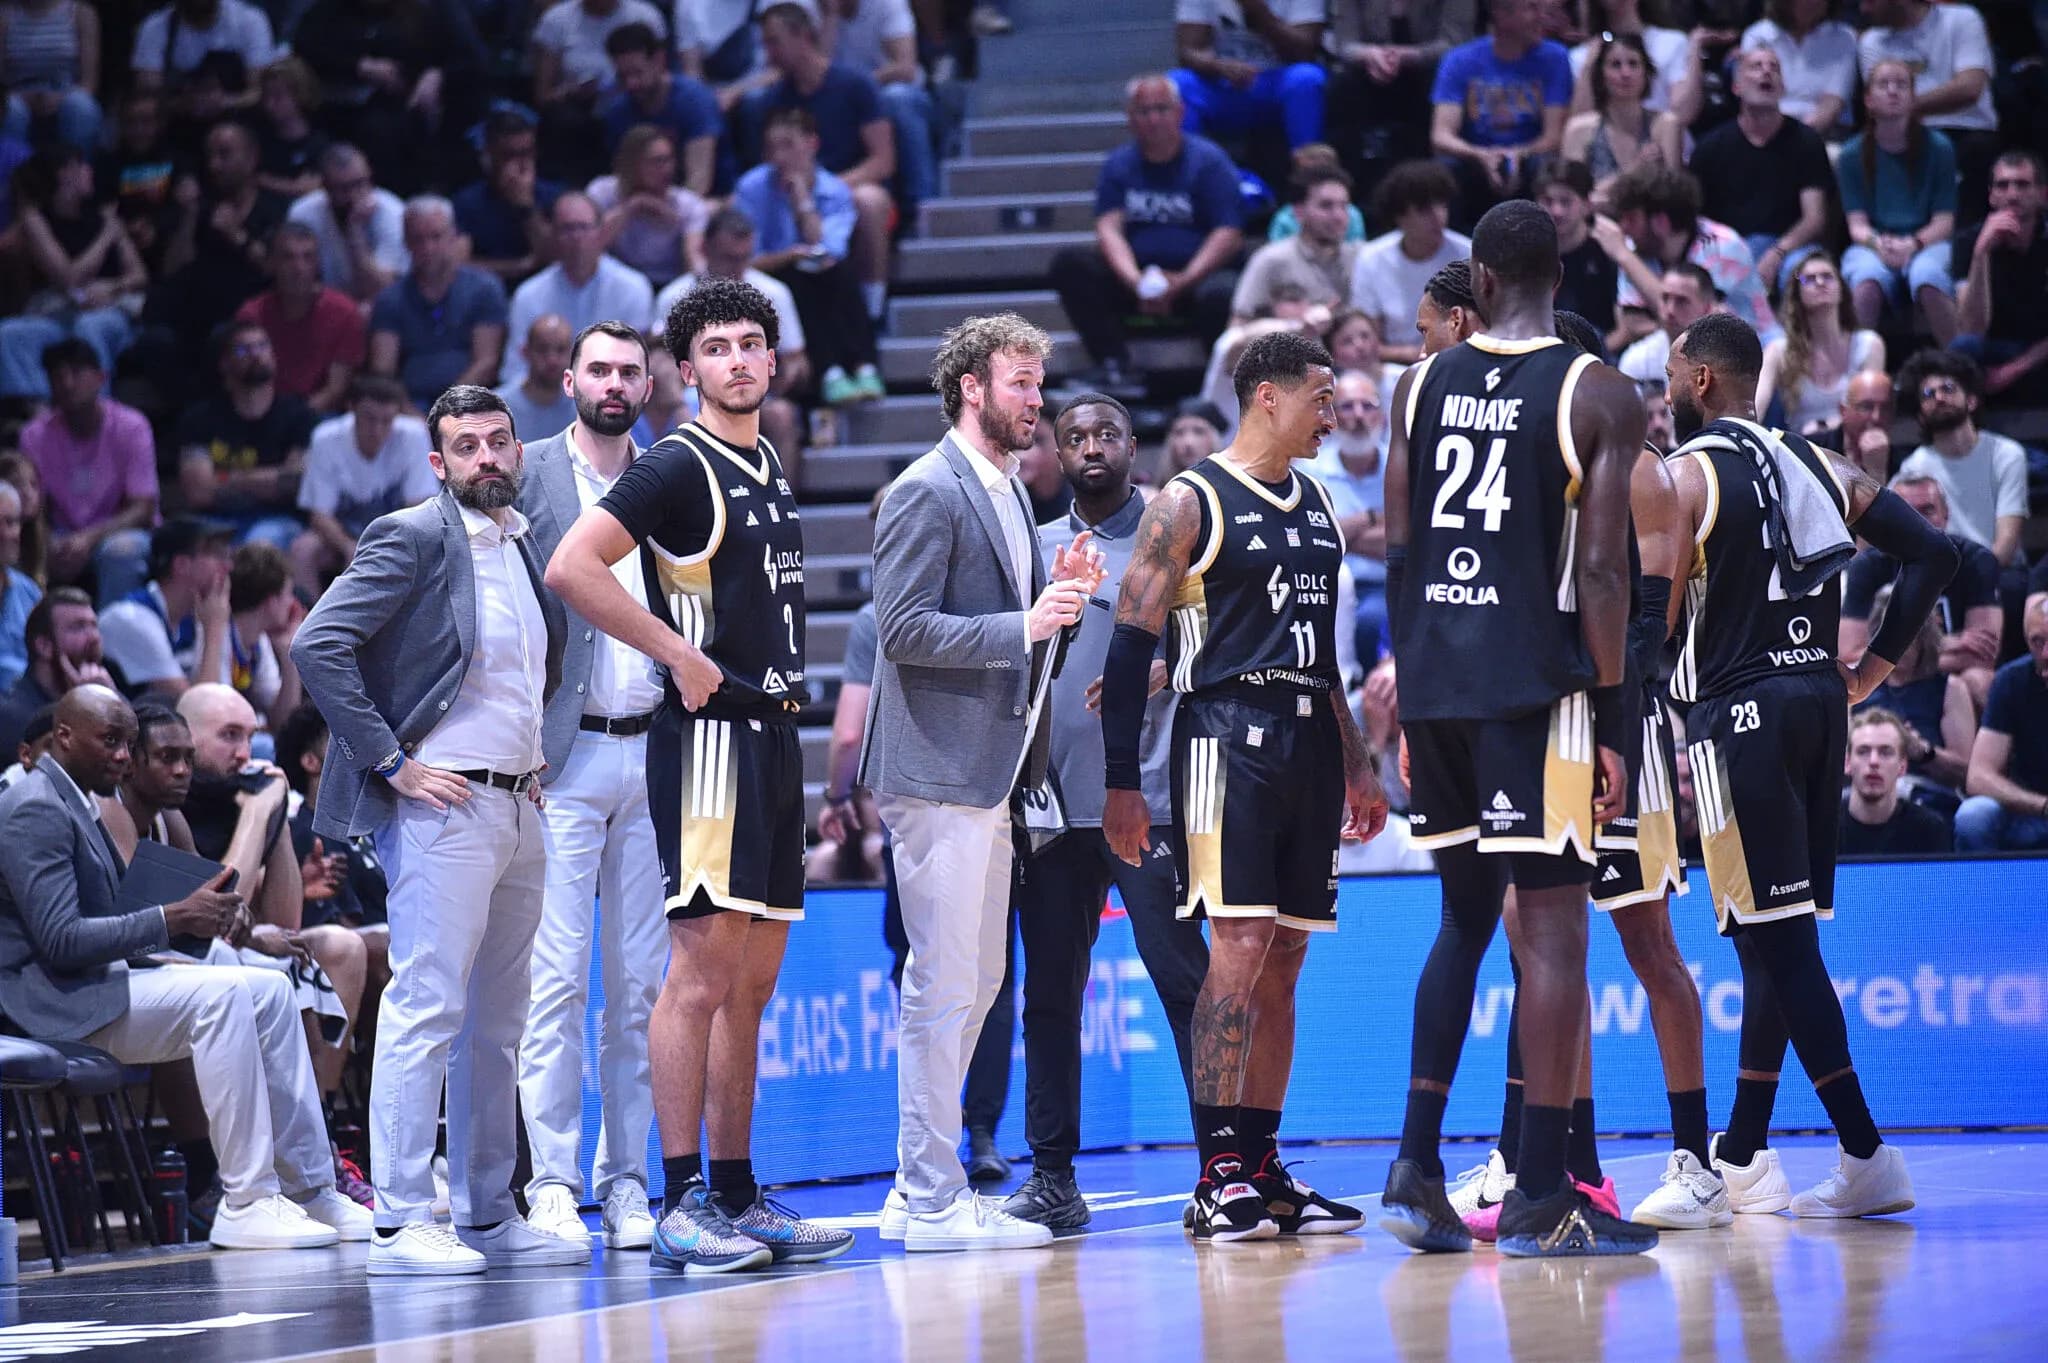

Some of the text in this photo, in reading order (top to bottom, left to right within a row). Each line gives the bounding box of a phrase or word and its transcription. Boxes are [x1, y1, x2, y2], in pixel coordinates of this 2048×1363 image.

[1441, 395, 1523, 431] NDIAYE
[1431, 434, 1512, 532] 24
[1234, 512, 1264, 524] swile
[1306, 510, 1329, 525] DCB
[1425, 583, 1500, 605] VEOLIA
[783, 603, 798, 655] 2
[1289, 620, 1316, 669] 11
[1767, 647, 1829, 667] VEOLIA
[1731, 700, 1761, 734] 23
[1493, 820, 1513, 831] BTP
[1224, 1185, 1249, 1199] NIKE
